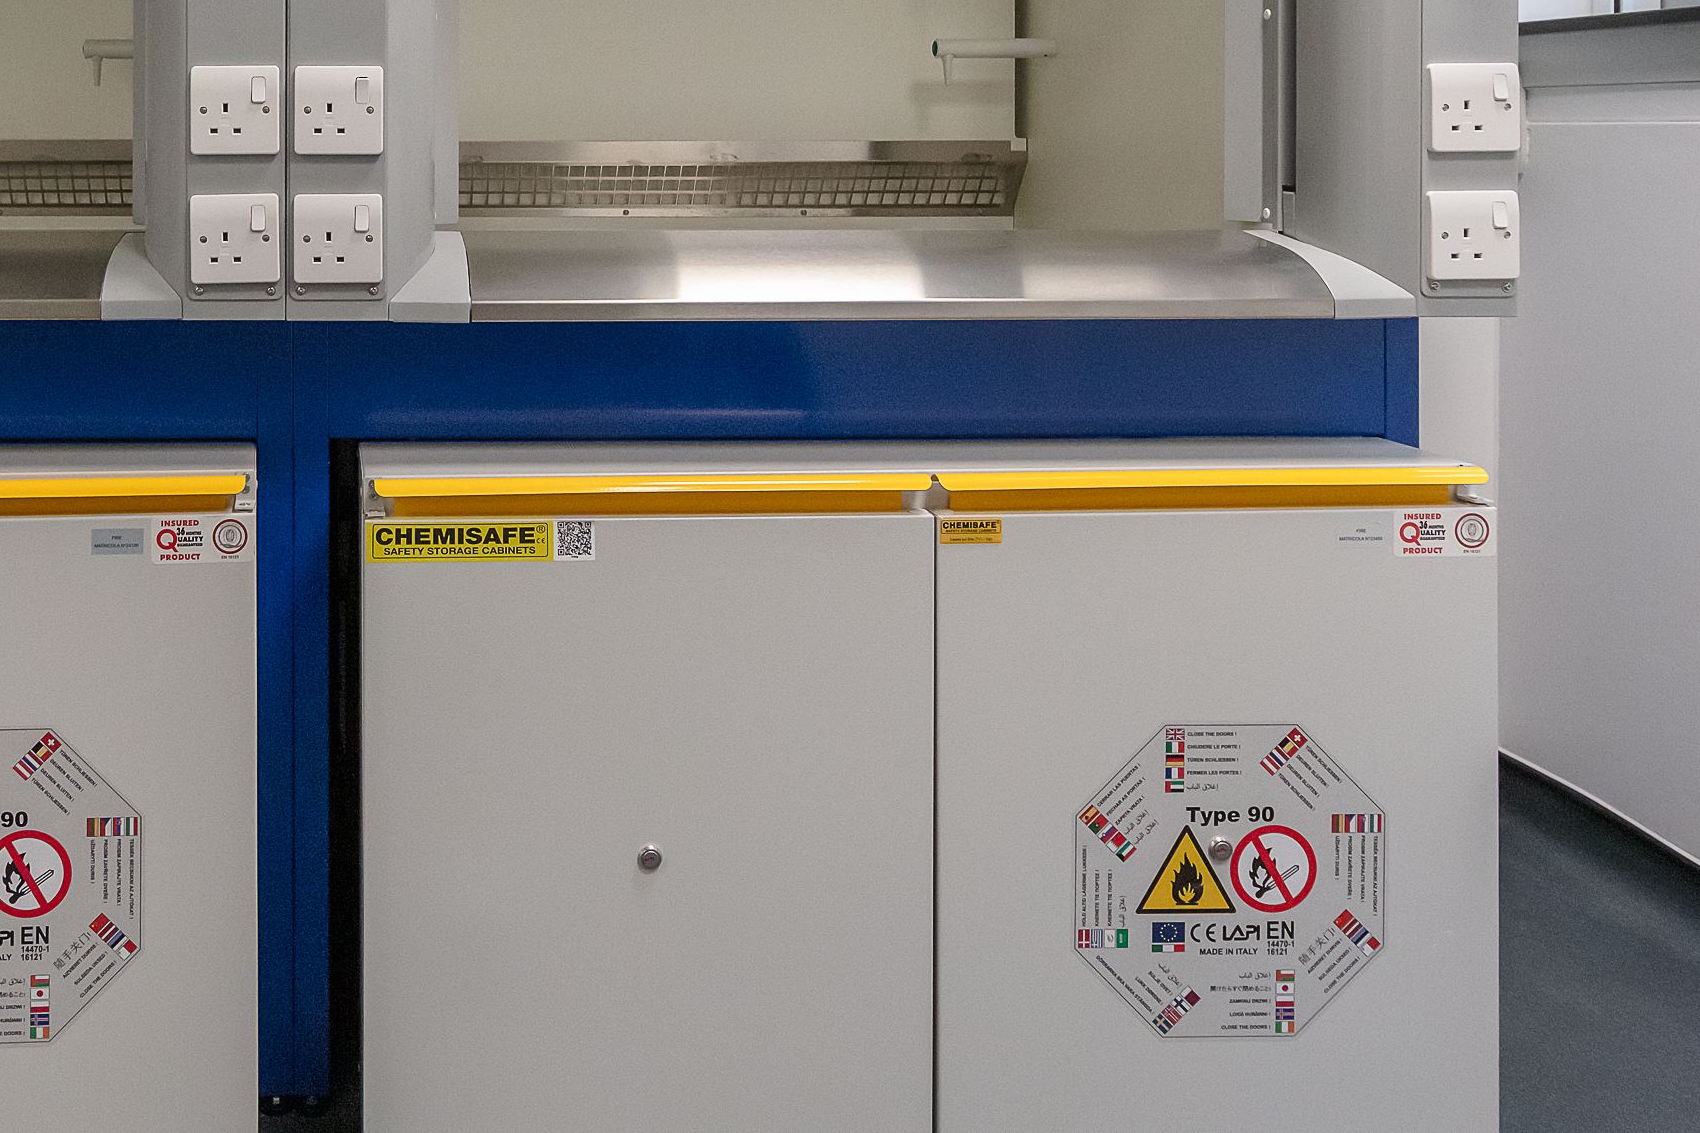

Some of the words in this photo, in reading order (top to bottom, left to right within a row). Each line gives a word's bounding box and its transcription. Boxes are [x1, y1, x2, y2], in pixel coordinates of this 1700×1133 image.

[160, 519, 200, 527] INSURED
[1419, 521, 1428, 530] 36
[176, 527, 186, 536] 36
[383, 547, 424, 556] SAFETY
[427, 546, 479, 556] STORAGE
[481, 546, 536, 555] CABINETS
[1403, 547, 1444, 555] PRODUCT
[160, 553, 201, 561] PRODUCT
[0, 811, 29, 828] 90
[1185, 806, 1241, 827] Type
[1247, 806, 1275, 823] 90
[1266, 920, 1295, 940] EN
[20, 925, 50, 946] EN
[1266, 940, 1295, 948] 14470-1
[20, 945, 50, 954] 14470-1
[1199, 948, 1224, 956] MADE
[1225, 948, 1235, 956] IN
[1235, 948, 1259, 956] ITALY
[1266, 948, 1288, 956] 16121
[20, 953, 43, 962] 16121
[77, 982, 94, 998] CLOSE
[98, 961, 116, 978] DOORS
